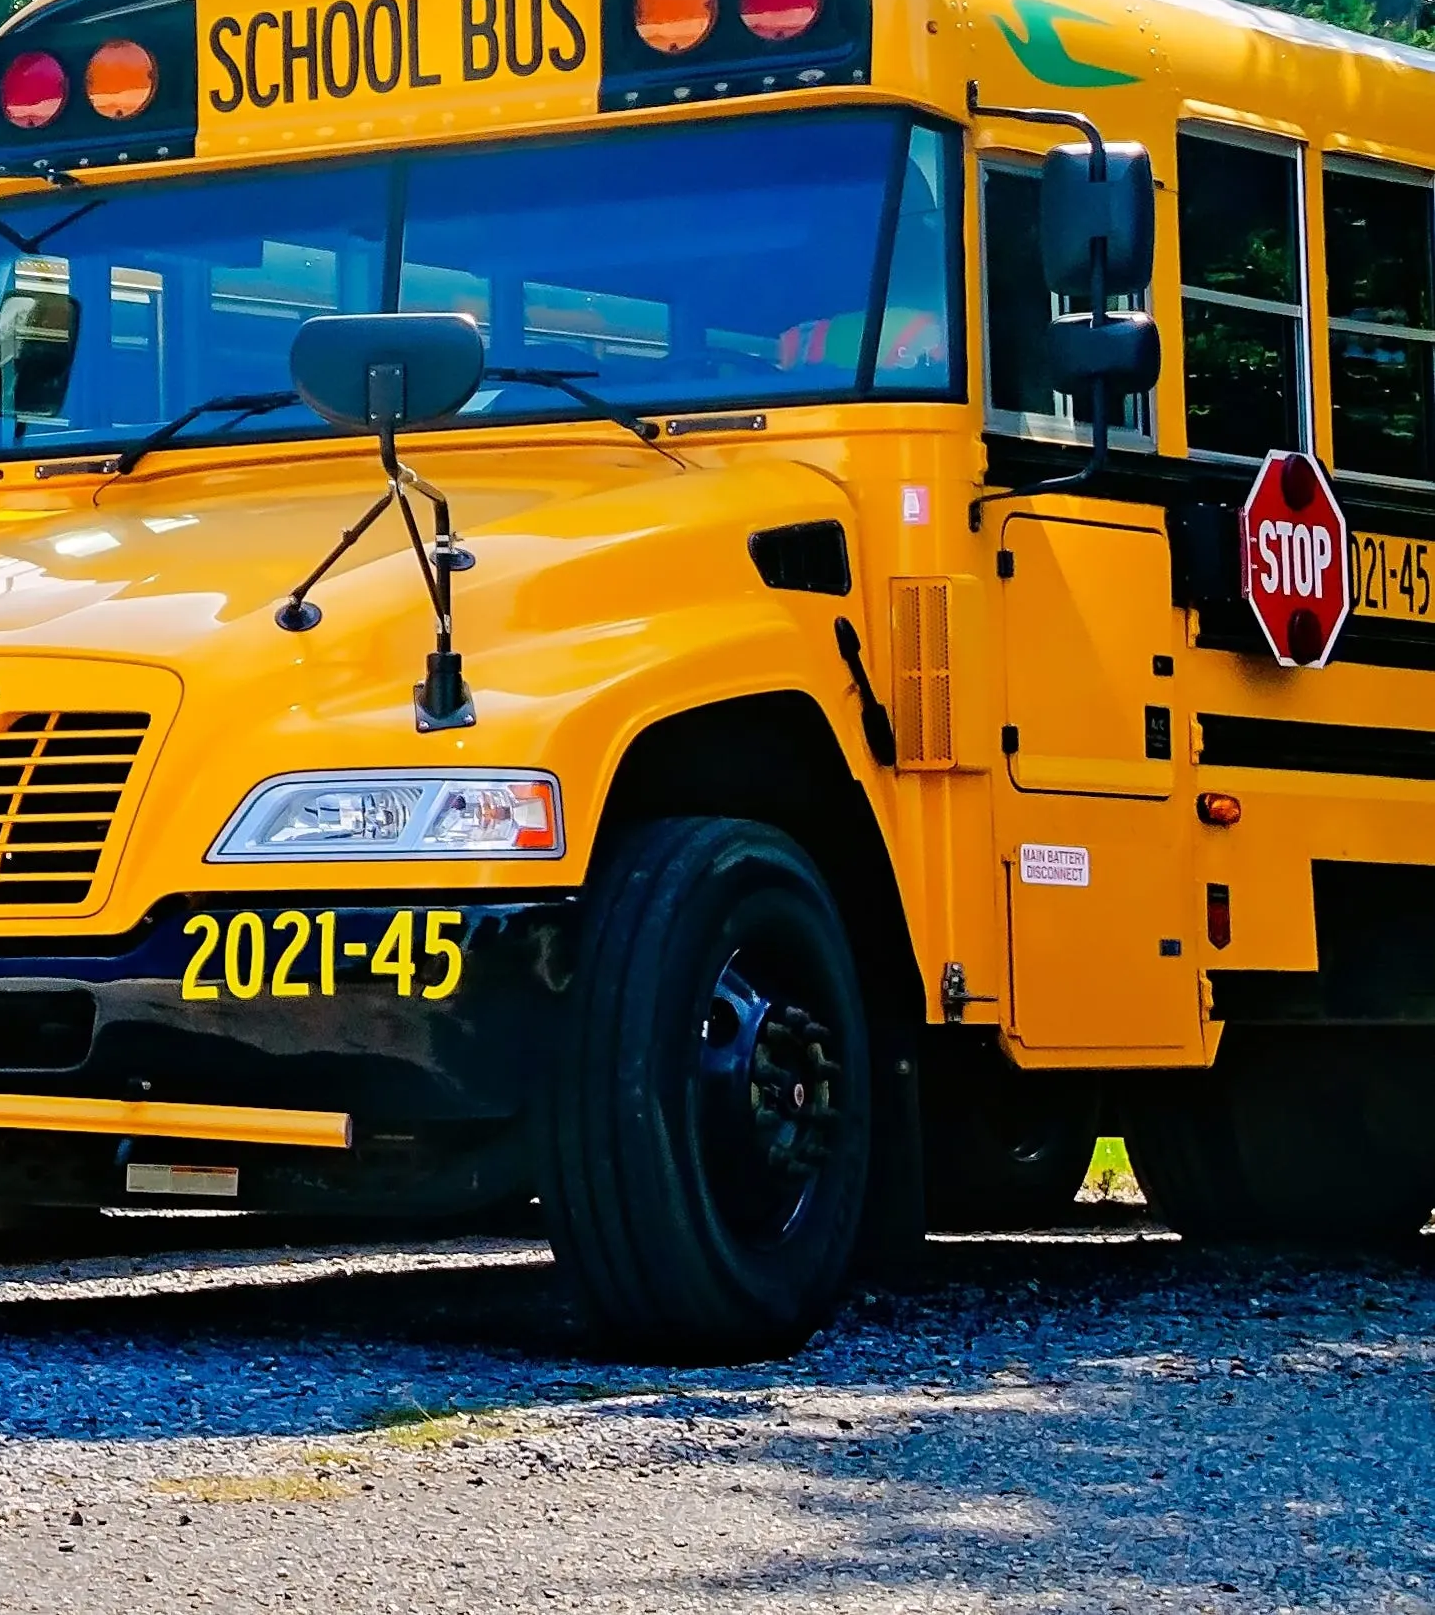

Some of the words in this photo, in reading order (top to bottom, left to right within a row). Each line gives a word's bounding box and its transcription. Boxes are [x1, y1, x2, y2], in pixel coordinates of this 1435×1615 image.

[1258, 519, 1332, 599] STOP
[1349, 535, 1431, 615] 021-45
[1023, 849, 1045, 863] MAIN
[1047, 850, 1086, 865] BATTERY
[1026, 865, 1083, 881] DISCONNECT
[181, 910, 463, 1001] 2021-45
